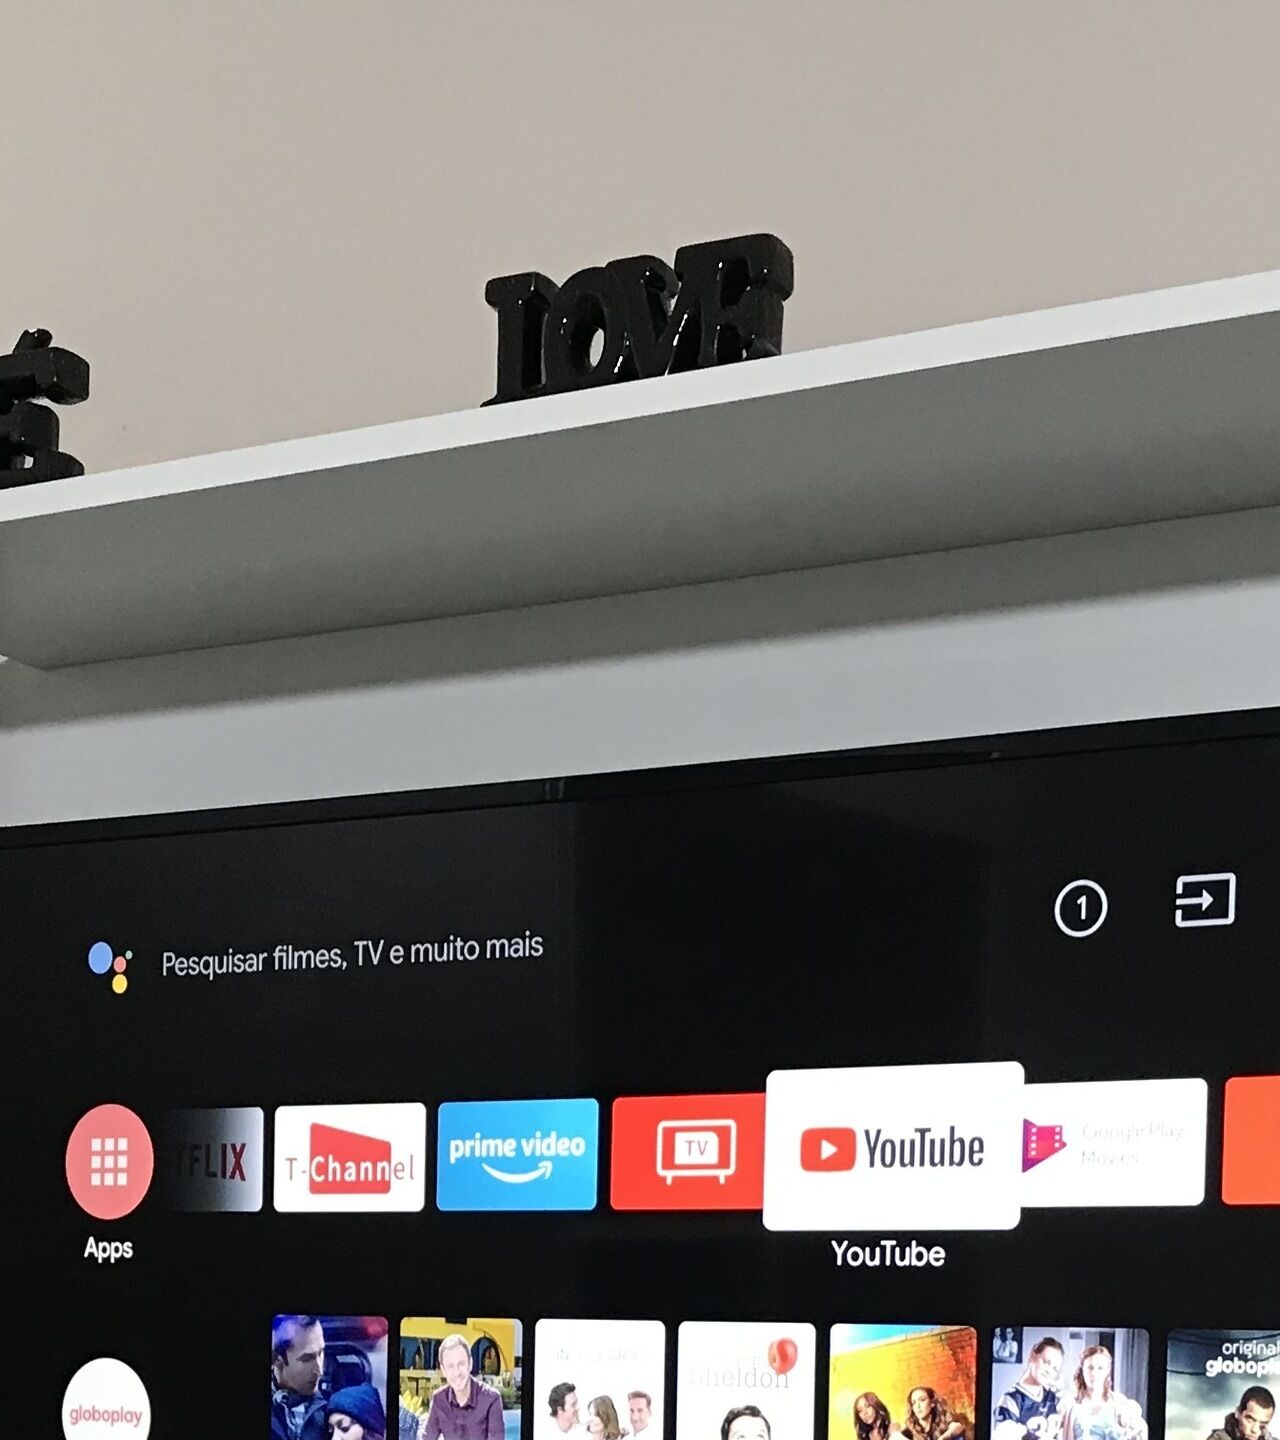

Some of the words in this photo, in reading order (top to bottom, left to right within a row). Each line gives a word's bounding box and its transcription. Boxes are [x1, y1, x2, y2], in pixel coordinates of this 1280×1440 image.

[161, 950, 269, 981] Pesquisar
[273, 943, 348, 972] filmes,
[354, 939, 386, 967] TV
[389, 946, 404, 966] e
[410, 934, 480, 963] muito
[485, 929, 544, 959] mais
[449, 1133, 517, 1165] prime
[519, 1129, 586, 1159] video
[685, 1139, 709, 1157] TV
[864, 1125, 985, 1171] YouTube
[285, 1152, 415, 1184] T-Channel
[83, 1236, 134, 1263] Apps
[831, 1240, 946, 1267] YouTube
[1221, 1340, 1280, 1359] original
[68, 1404, 143, 1428] globoplay
